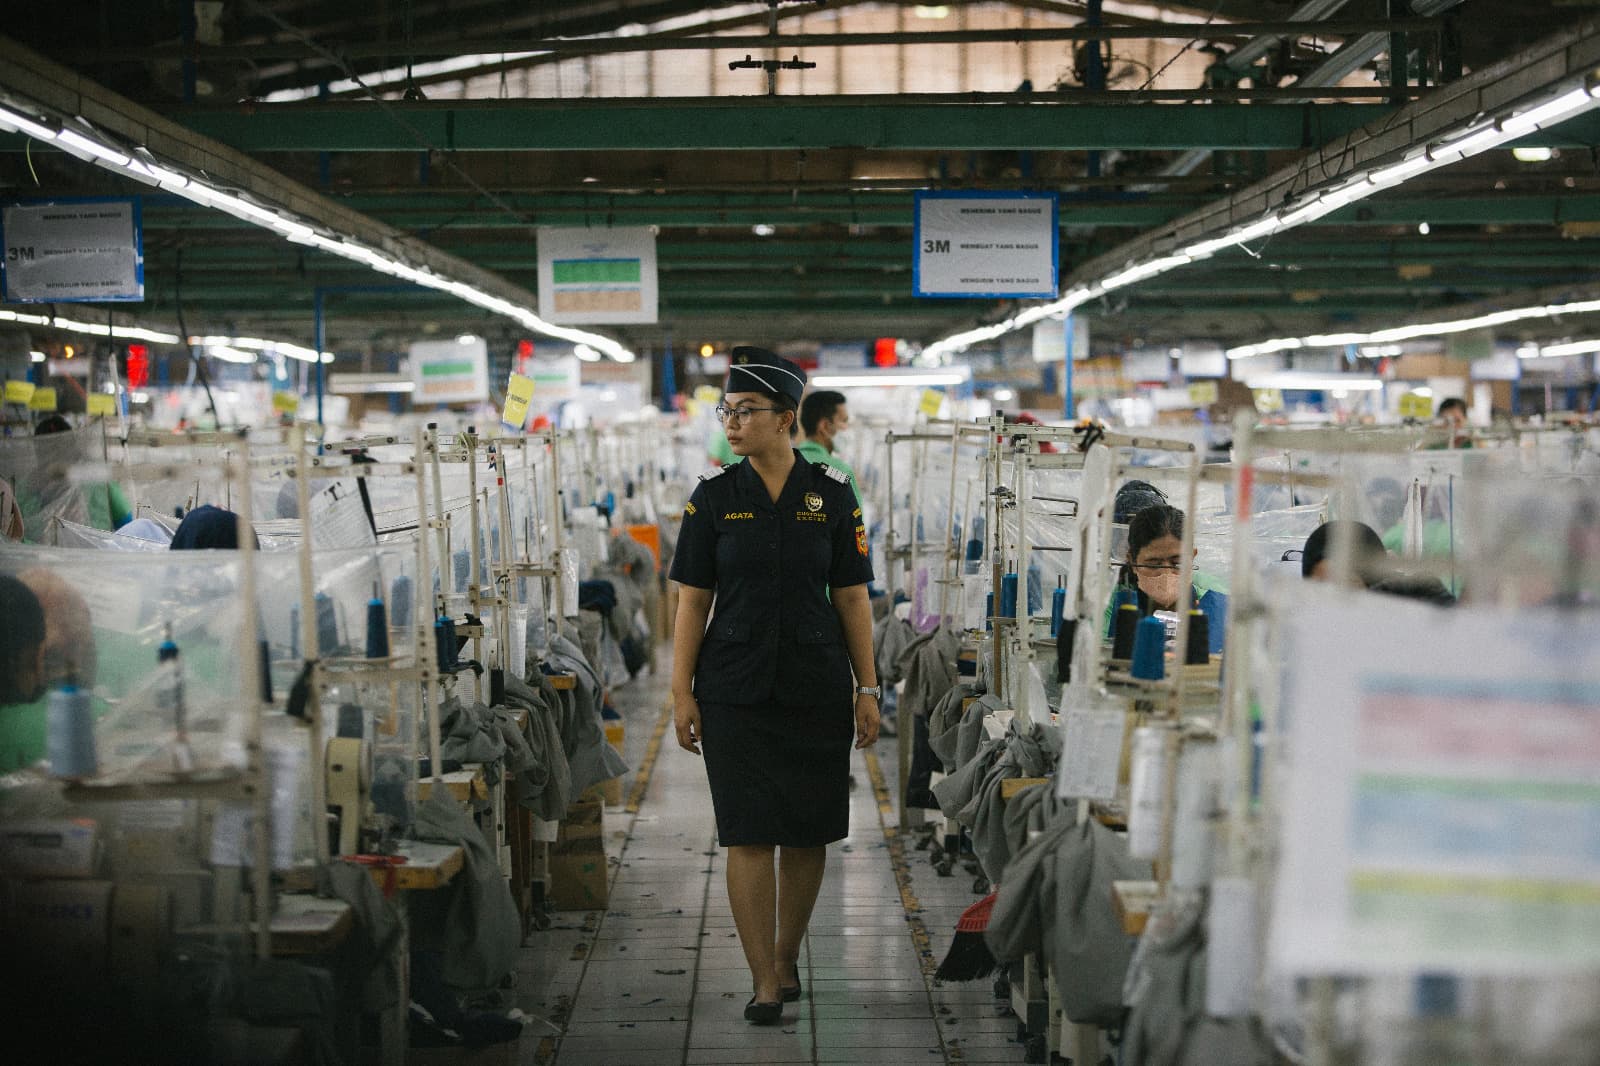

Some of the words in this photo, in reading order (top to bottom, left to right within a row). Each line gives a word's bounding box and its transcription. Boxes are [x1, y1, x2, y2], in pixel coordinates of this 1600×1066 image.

[923, 240, 950, 253] 3M
[8, 247, 35, 261] 3M
[724, 512, 754, 520] AGATA
